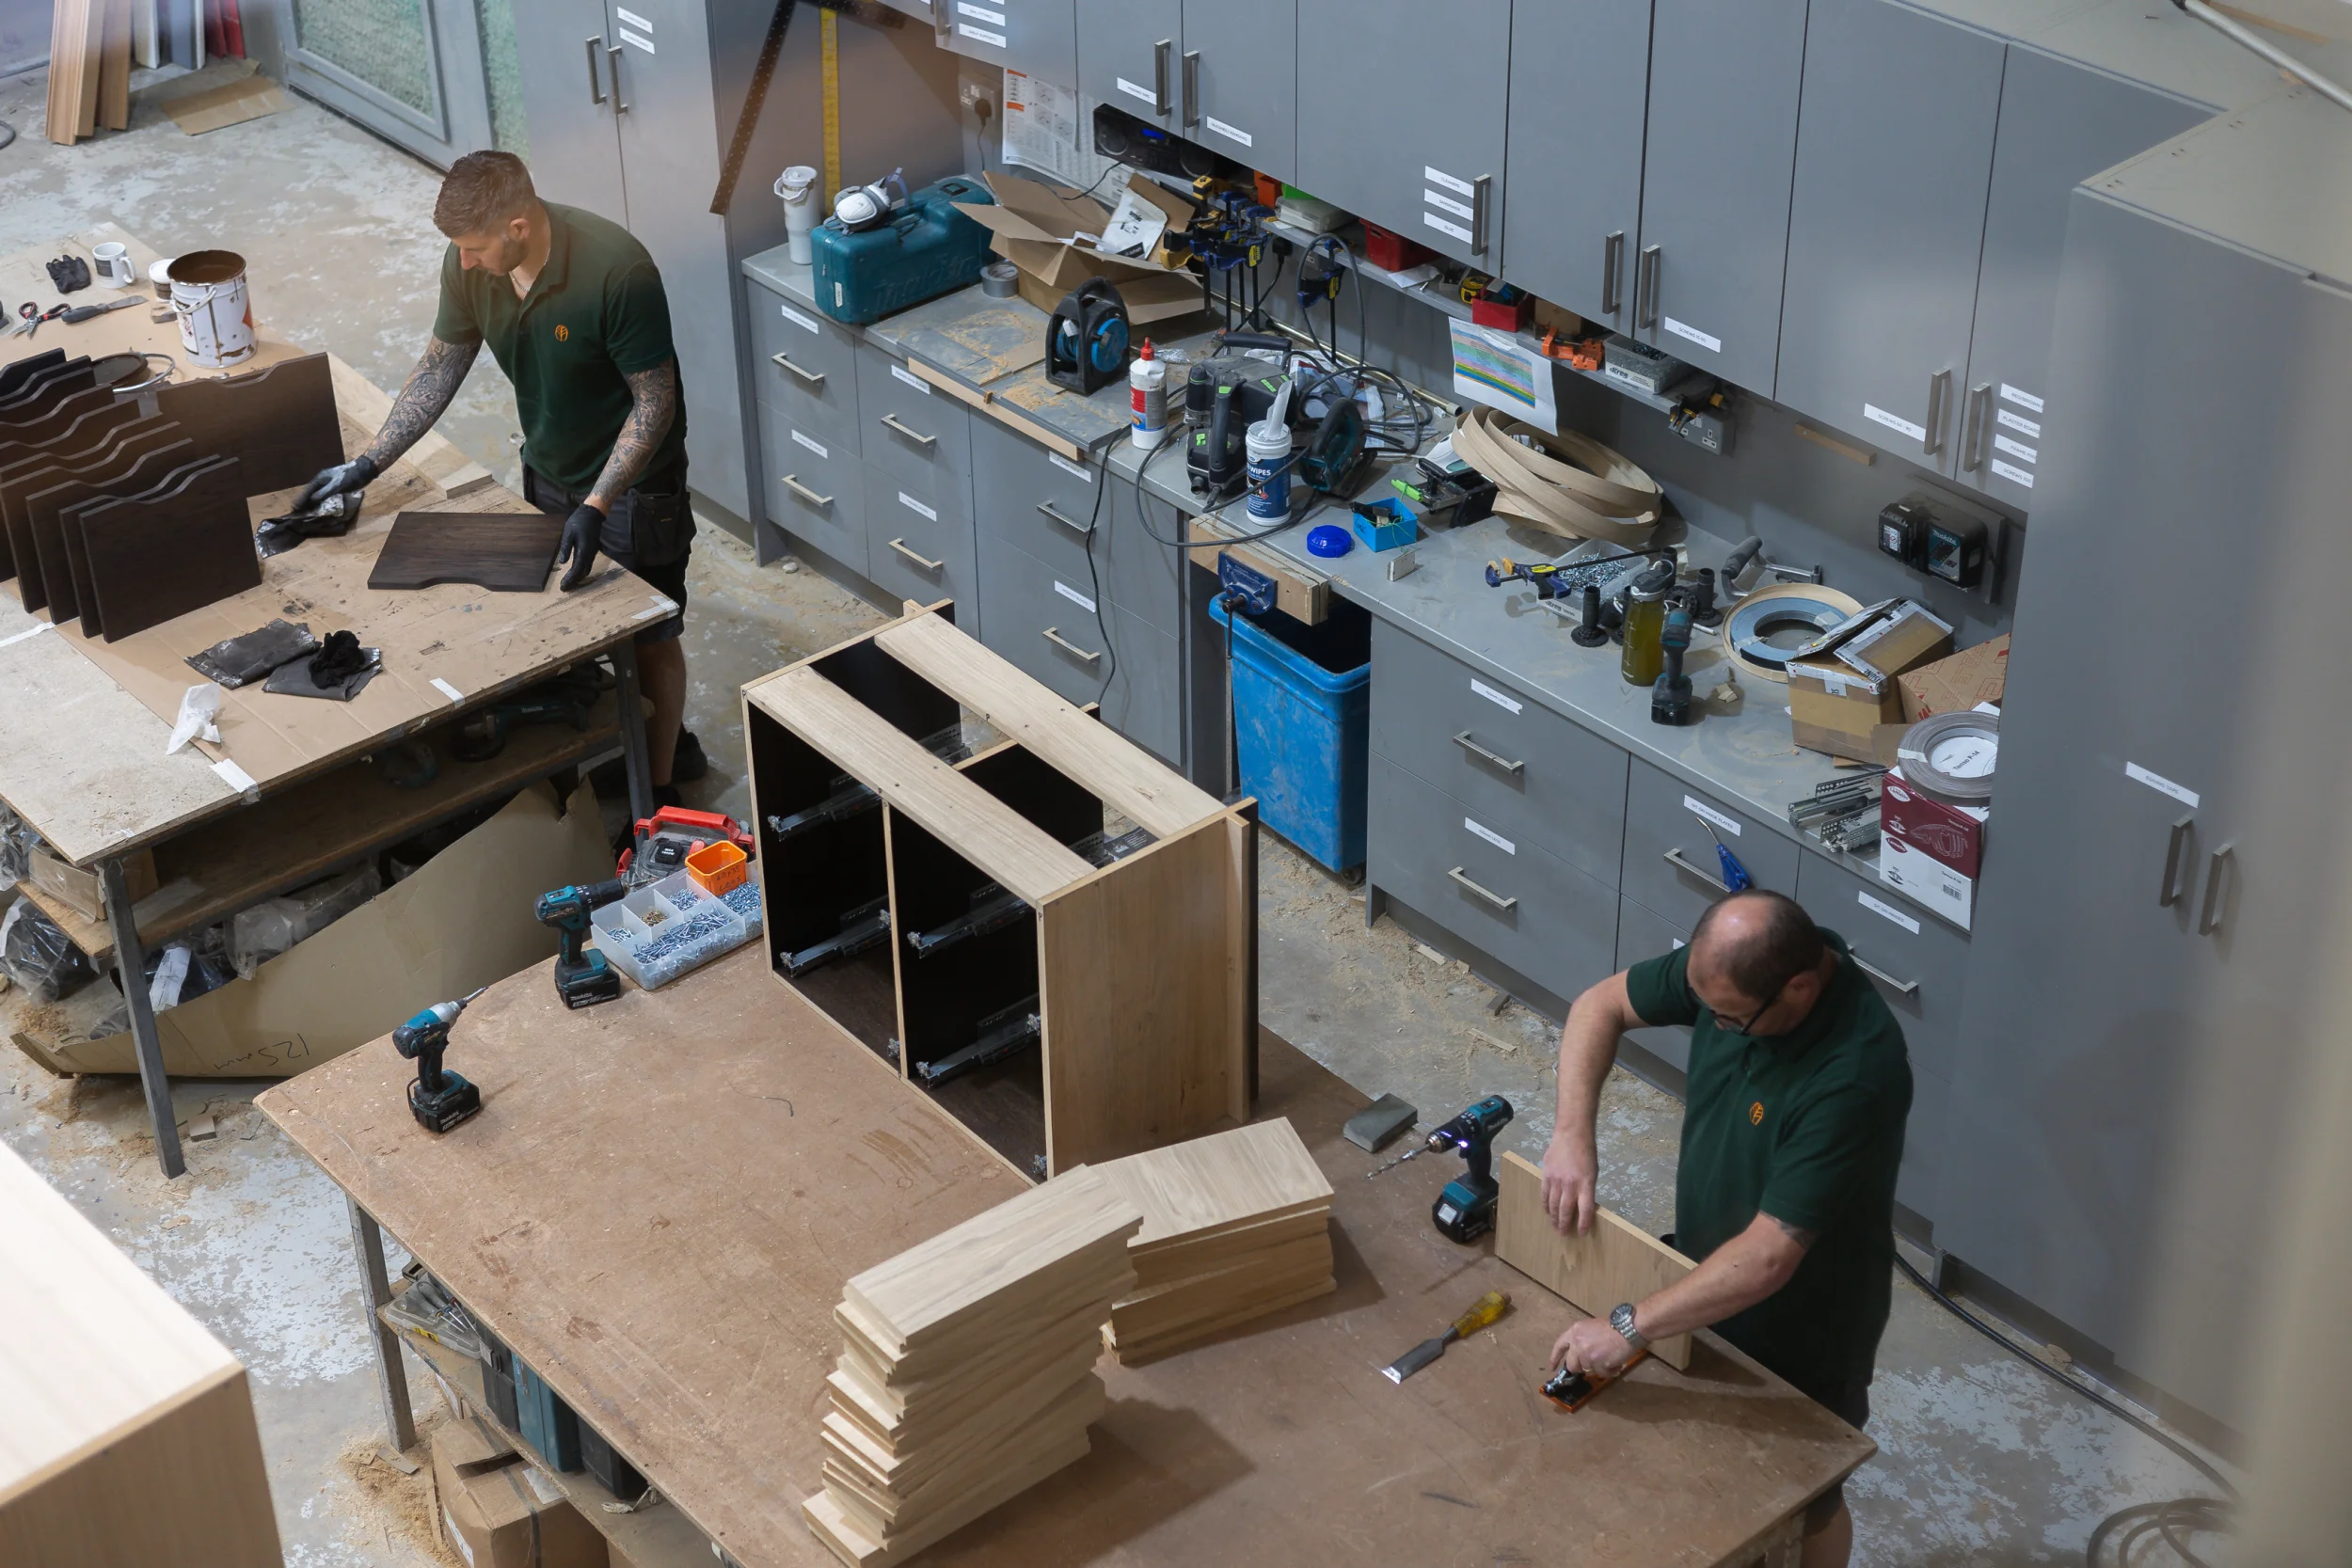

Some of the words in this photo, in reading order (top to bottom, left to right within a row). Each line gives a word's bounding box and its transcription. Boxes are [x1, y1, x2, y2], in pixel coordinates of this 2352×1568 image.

[1440, 176, 1459, 189] CLEANERS
[1438, 198, 1460, 213] SANDPAPER
[1444, 224, 1454, 232] GLUE
[1678, 326, 1694, 338] SCREWS
[1610, 367, 1629, 378] Kreg
[1878, 413, 1895, 425] SCREWS
[2002, 415, 2023, 428] PLASTER
[2003, 467, 2023, 481] SCREWS
[1932, 529, 1957, 546] makita
[1498, 696, 1508, 705] LEGS
[1952, 758, 1970, 769] Tenso
[2166, 785, 2179, 795] TAPE
[1717, 817, 1733, 829] PLATES
[1491, 836, 1502, 845] LEGS
[1887, 911, 1904, 923] HINGES
